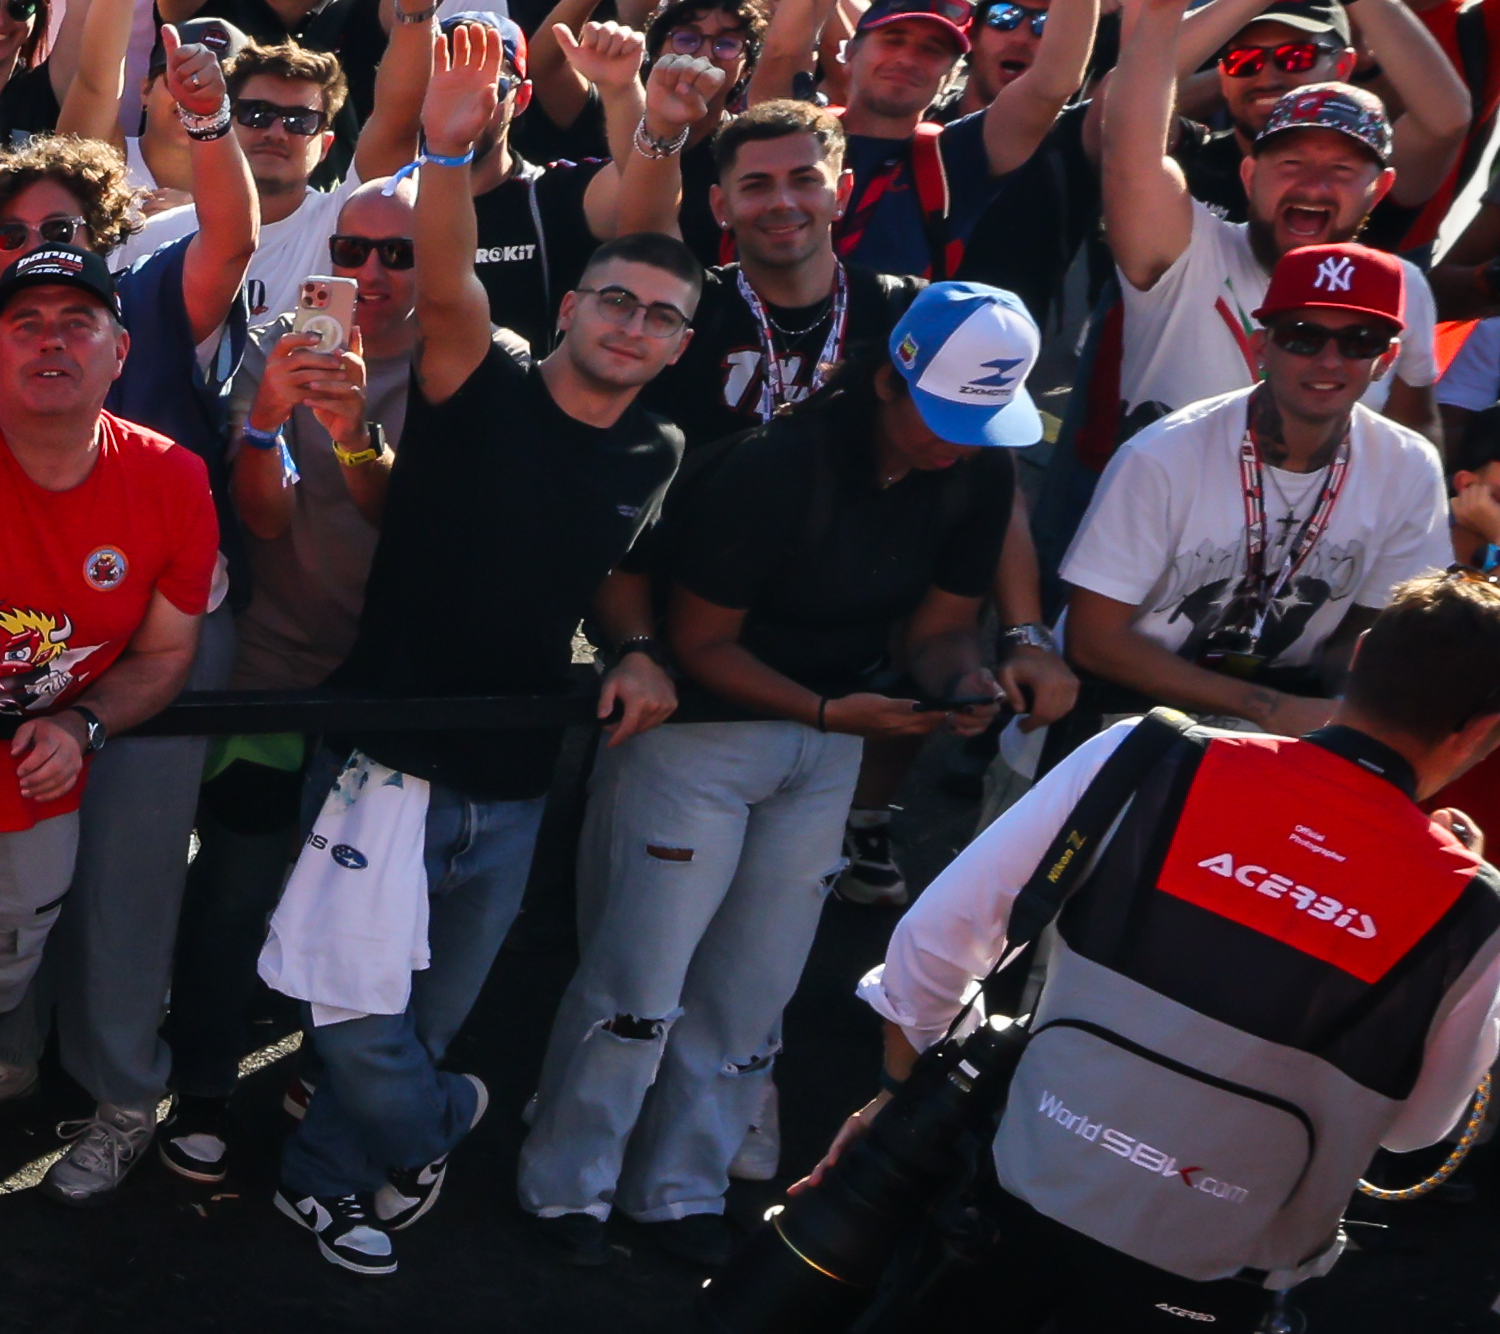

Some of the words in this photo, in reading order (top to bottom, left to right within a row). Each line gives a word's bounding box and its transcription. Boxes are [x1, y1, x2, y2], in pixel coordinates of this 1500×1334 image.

[476, 244, 536, 264] ROKiT
[1046, 847, 1078, 884] Nikon
[1197, 851, 1380, 941] ACERBIS
